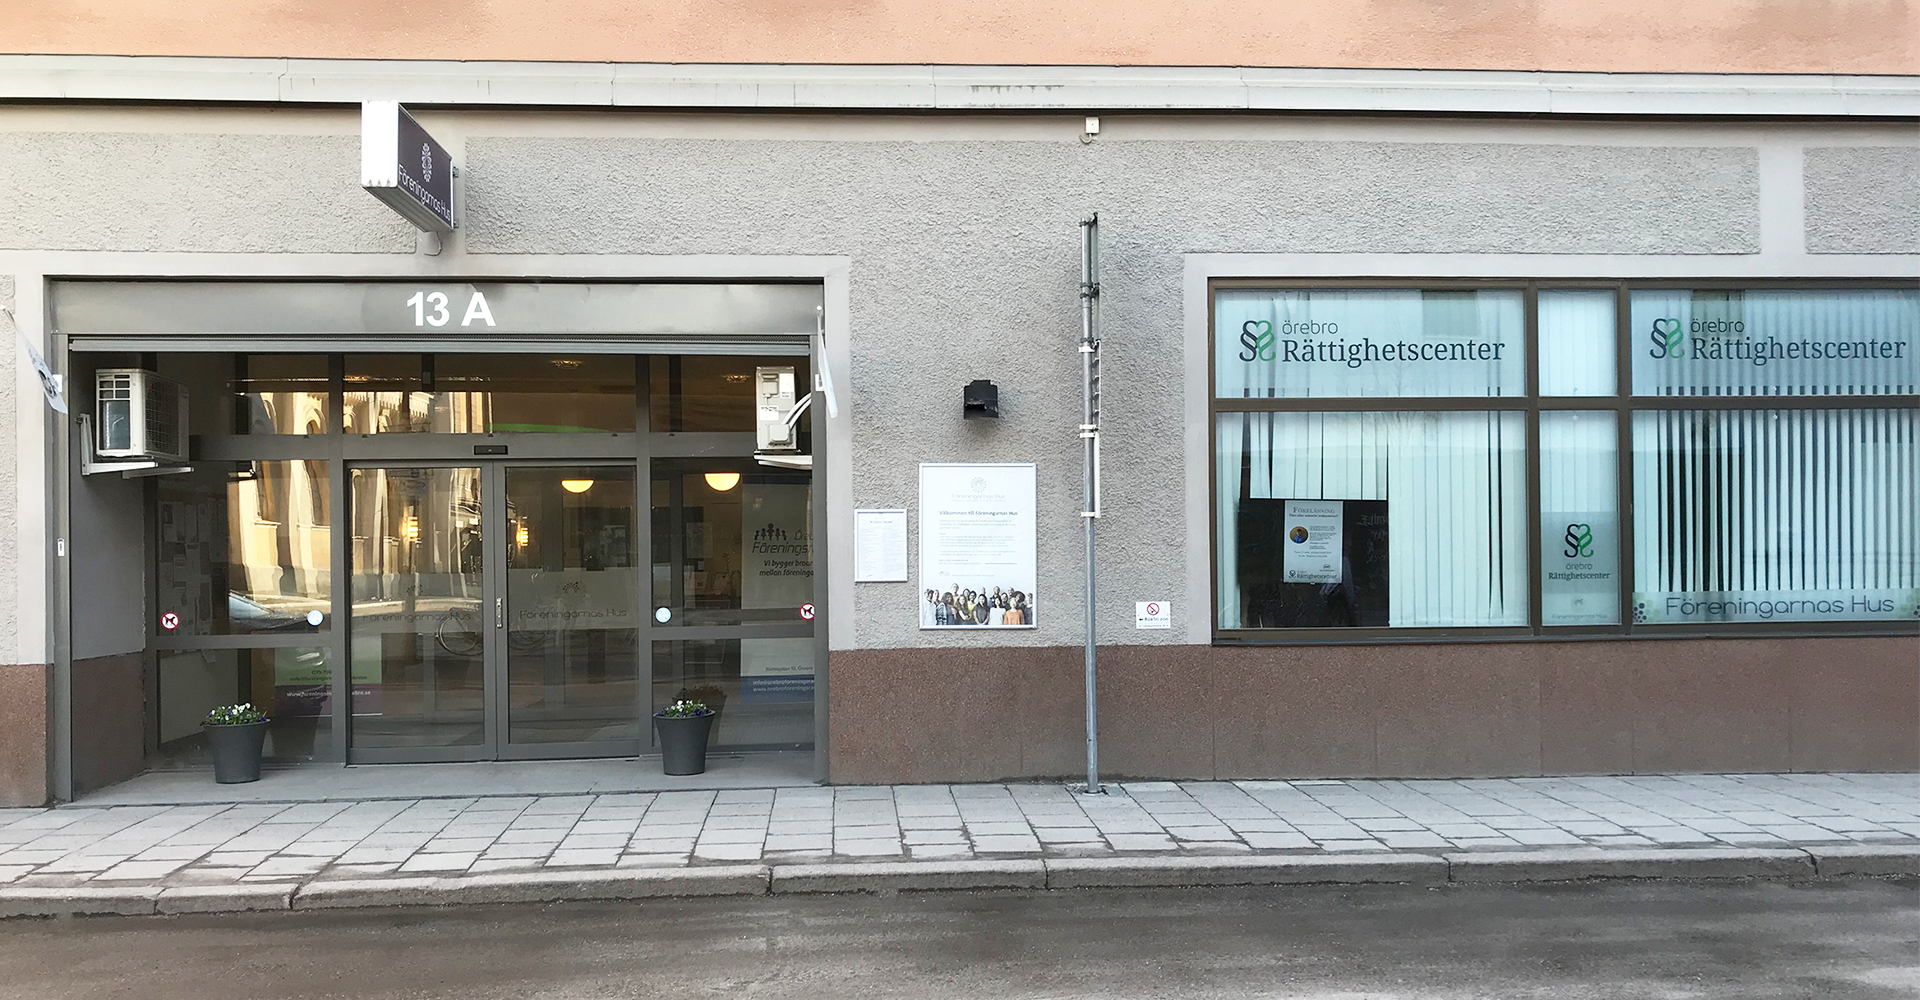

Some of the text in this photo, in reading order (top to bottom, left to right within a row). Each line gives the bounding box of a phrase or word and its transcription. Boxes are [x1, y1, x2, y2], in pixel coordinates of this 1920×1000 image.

[399, 164, 451, 221] Föreningarnas Hus
[407, 291, 497, 327] 13 A
[1282, 320, 1339, 335] örebro
[1691, 318, 1745, 333] örebro
[1282, 338, 1506, 368] Rättighetscenter
[1691, 336, 1906, 366] Rättighetscenter
[772, 560, 795, 568] bygger
[1548, 572, 1611, 581] Rättighetscenter
[606, 608, 627, 617] Hus
[1666, 595, 1895, 619] Föreningarnas Hus
